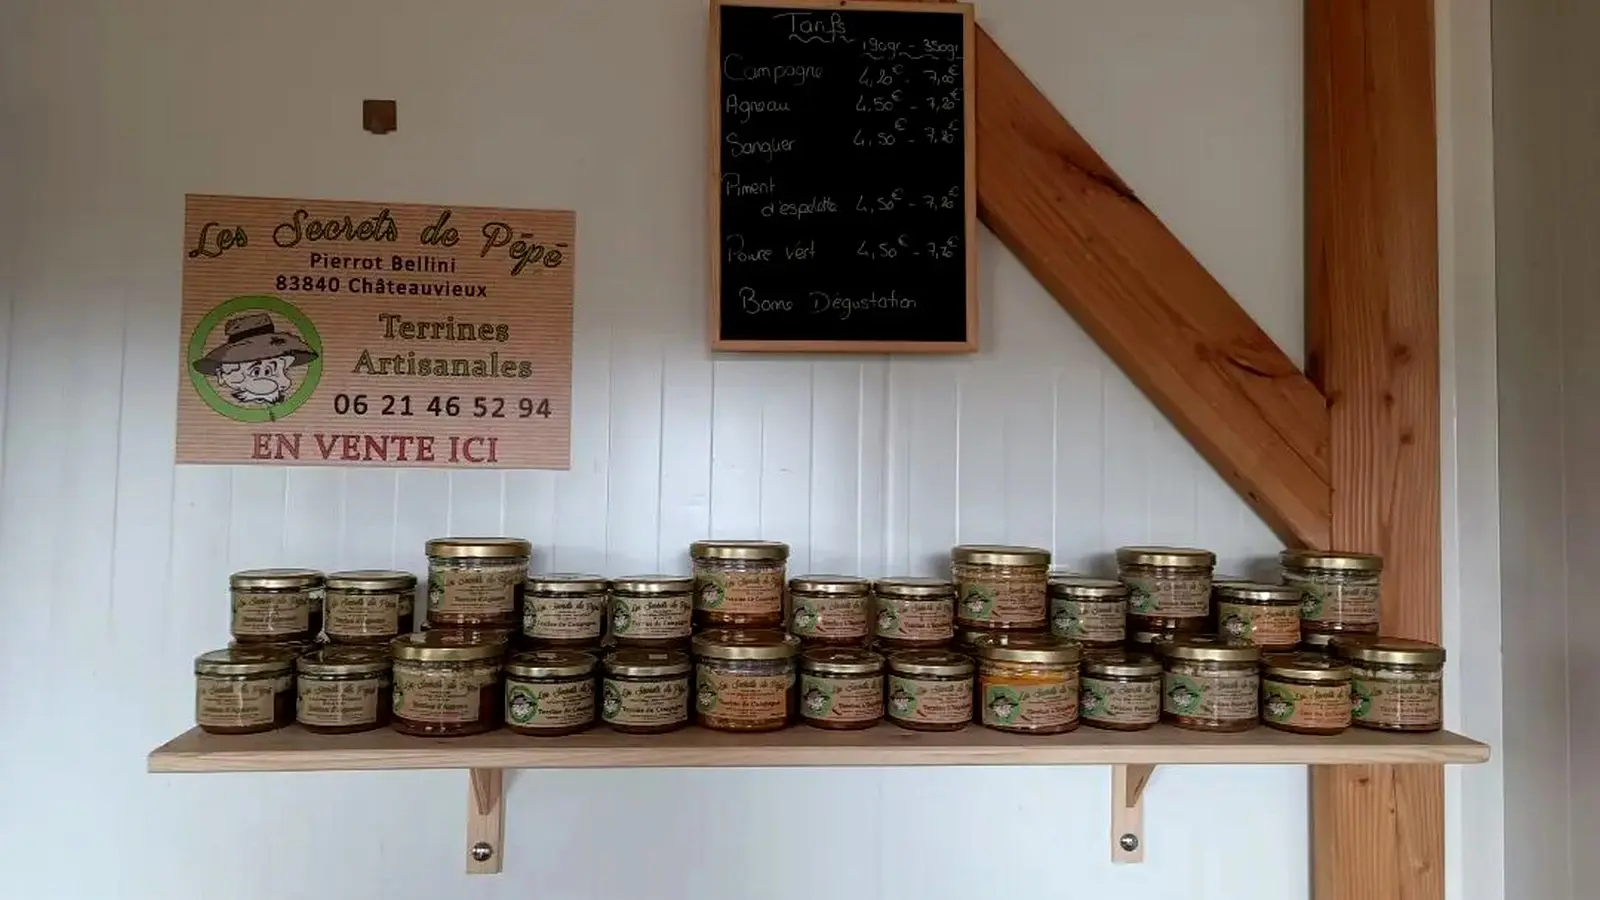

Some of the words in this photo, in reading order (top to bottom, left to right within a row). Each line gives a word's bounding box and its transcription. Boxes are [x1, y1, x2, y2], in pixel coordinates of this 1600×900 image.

[772, 12, 846, 43] Tarifs
[723, 53, 823, 86] Campagne
[725, 94, 791, 124] Agneau
[722, 172, 776, 198] Piment
[188, 222, 248, 258] Les
[272, 208, 398, 248] Secrets
[420, 209, 460, 248] de
[309, 252, 383, 271] Pierrot
[391, 255, 456, 273] Bellini
[275, 274, 340, 293] 83840
[348, 277, 487, 298] Châteauvieux
[808, 289, 917, 321] Dégustation
[378, 313, 510, 342] Terrines
[352, 348, 533, 379] Artisanales
[333, 394, 368, 416] 06
[381, 395, 414, 416] 21
[426, 396, 460, 417] 46
[472, 397, 505, 418] 52
[518, 397, 552, 419] 94
[251, 432, 302, 460] EN
[314, 433, 435, 462] VENTE
[448, 436, 499, 463] ICI
